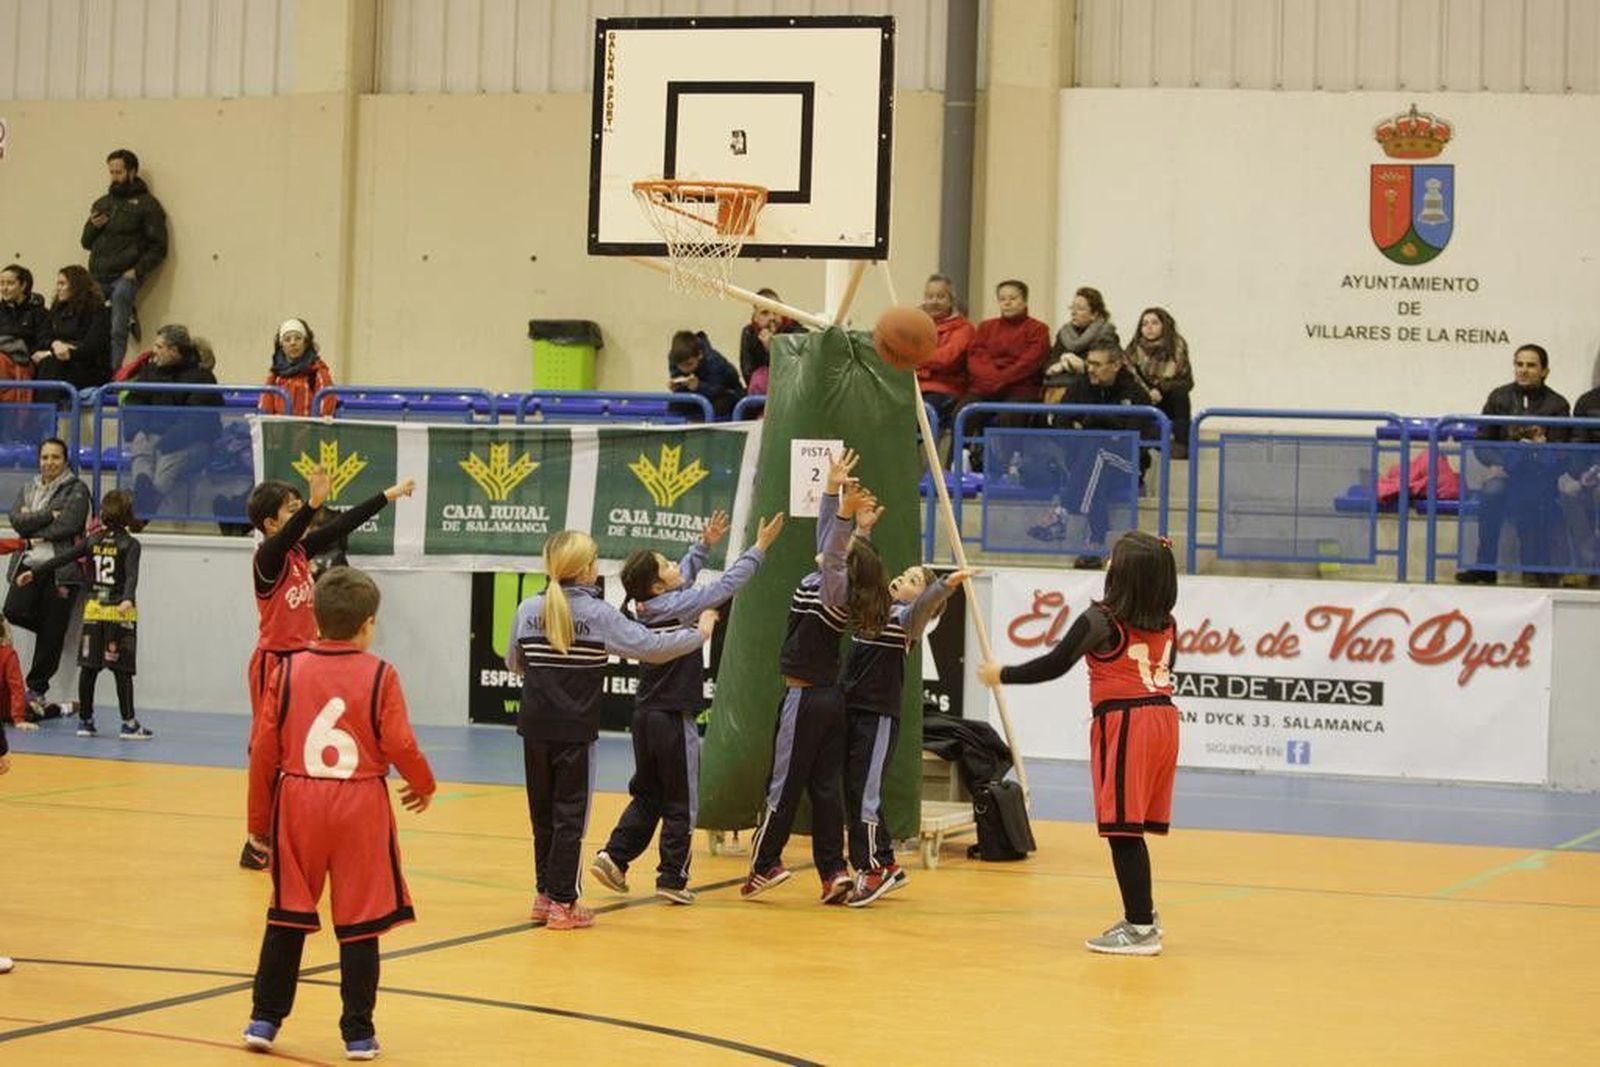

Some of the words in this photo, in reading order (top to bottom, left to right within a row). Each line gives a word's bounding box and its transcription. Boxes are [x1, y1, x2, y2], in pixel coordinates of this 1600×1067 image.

[608, 32, 616, 80] GALVAN
[1341, 275, 1479, 292] AYUNTAMIENTO
[1397, 301, 1421, 316] DE
[1305, 324, 1391, 341] VILLARES
[1397, 327, 1421, 342] DE
[1426, 327, 1450, 342] LA
[1455, 328, 1510, 344] REINA
[801, 447, 831, 457] PISTA
[811, 468, 821, 482] 2
[442, 504, 486, 520] CAJA
[489, 505, 550, 521] RURAL
[608, 508, 650, 525] CAJA
[442, 521, 461, 532] DE
[466, 522, 548, 533] SALAMANCA
[607, 525, 626, 537] DE
[631, 527, 705, 543] SALAMANC
[93, 555, 116, 585] 12
[1008, 590, 1070, 648] El
[1256, 621, 1301, 659] de
[1305, 605, 1411, 664] Van
[1407, 608, 1536, 687] Dyck
[1169, 673, 1219, 698] BAR
[1227, 676, 1268, 701] DE
[1273, 679, 1373, 704] TAPAS
[1204, 712, 1245, 726] DYCK
[1251, 715, 1276, 728] 33.
[1282, 716, 1385, 733] SALAMANCA
[303, 696, 359, 779] 6
